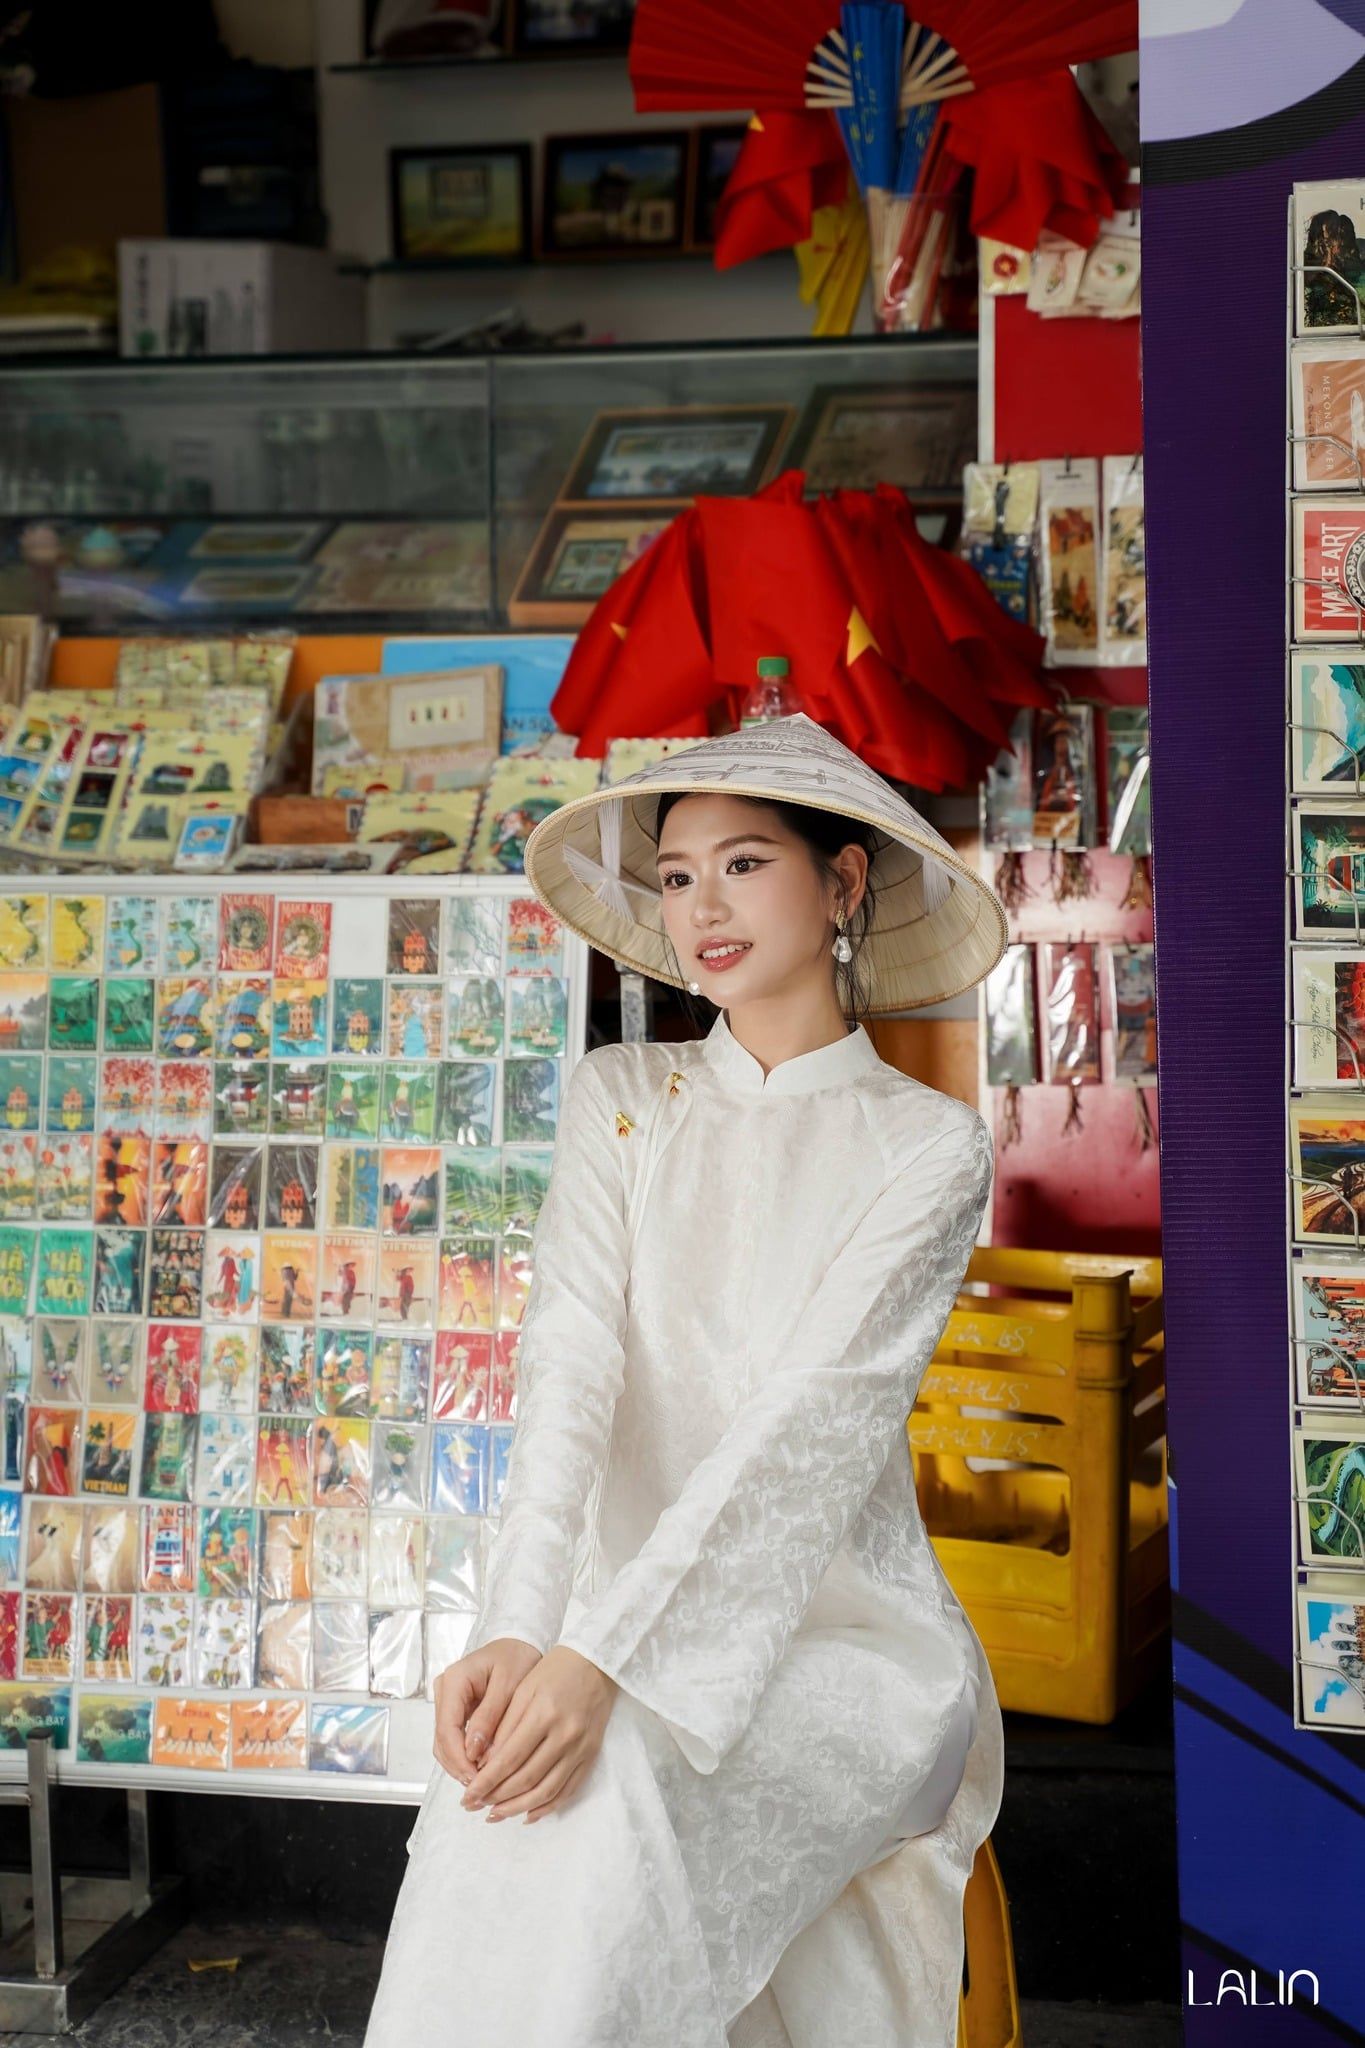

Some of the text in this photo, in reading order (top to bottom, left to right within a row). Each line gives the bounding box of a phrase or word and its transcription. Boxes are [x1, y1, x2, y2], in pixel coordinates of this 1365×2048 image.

[1322, 375, 1333, 431] MEKONG
[1321, 522, 1361, 618] MAKE ART
[83, 1479, 129, 1496] VIETNAM
[45, 1714, 66, 1726] BAY
[127, 1728, 149, 1740] BAY
